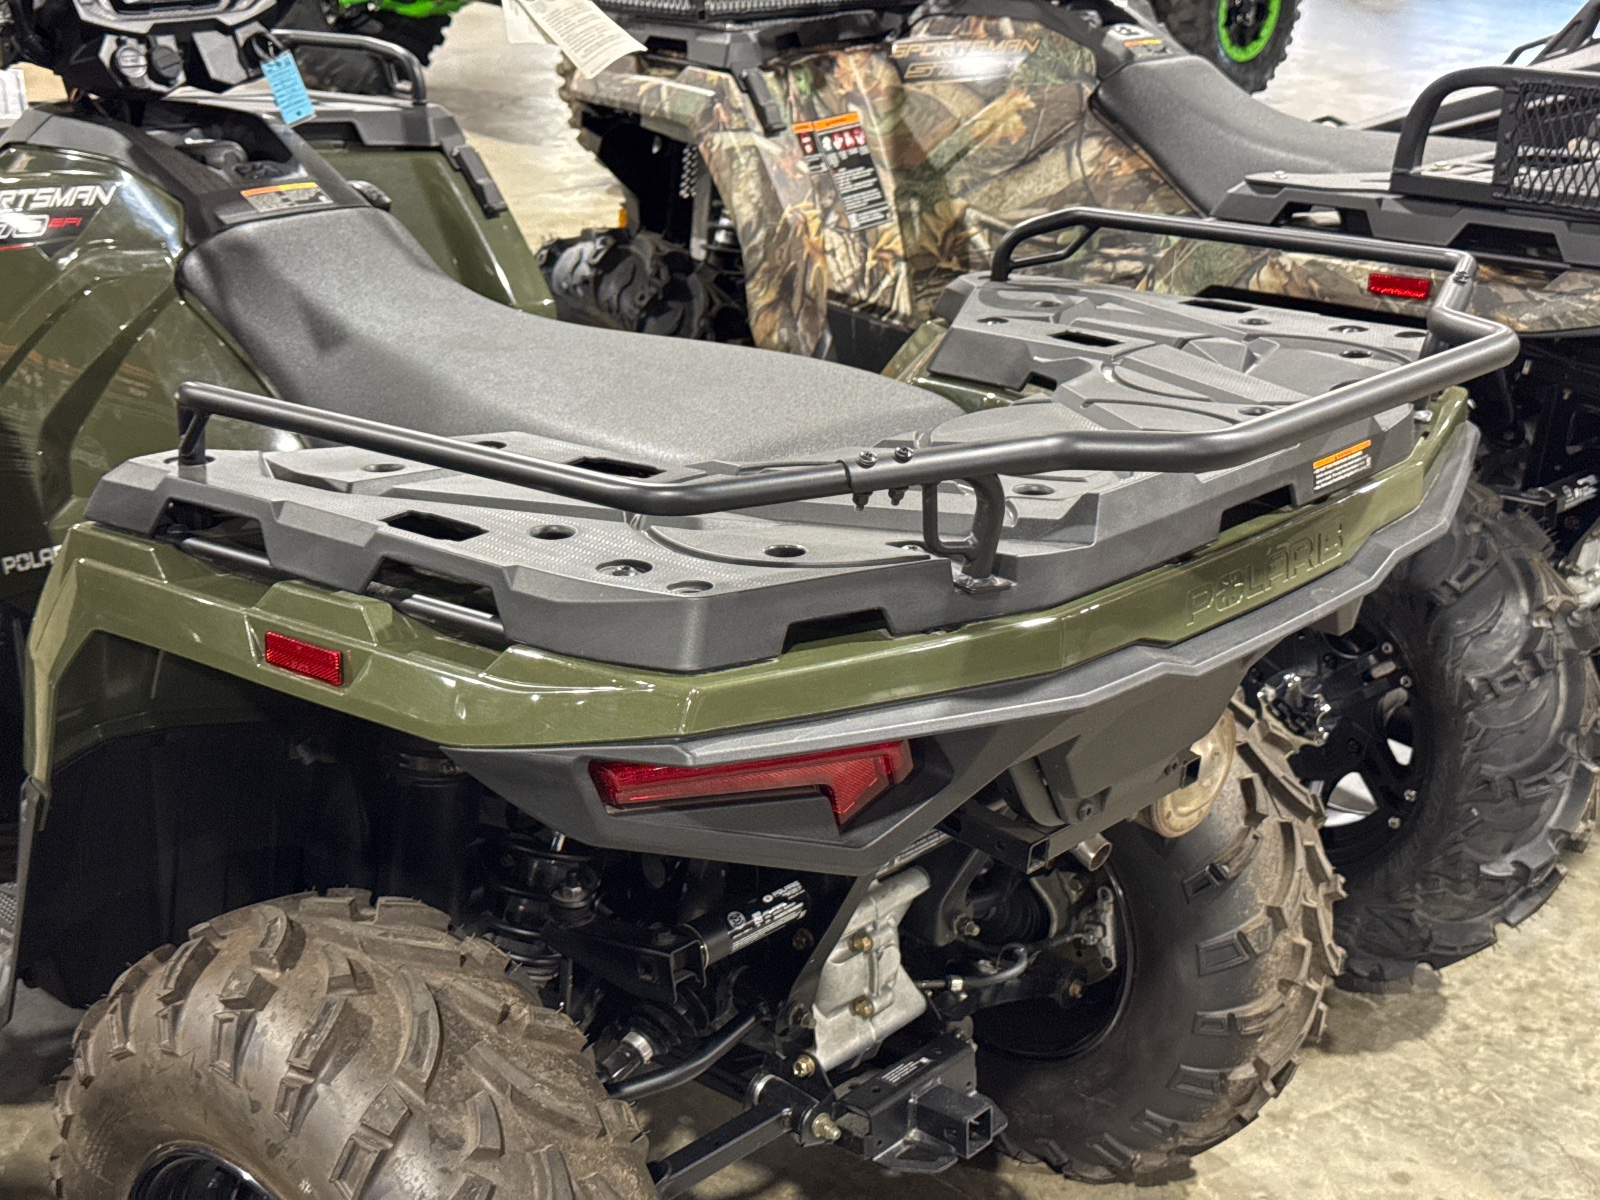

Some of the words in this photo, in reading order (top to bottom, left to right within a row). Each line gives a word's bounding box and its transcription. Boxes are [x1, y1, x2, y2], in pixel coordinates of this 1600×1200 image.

[889, 38, 1041, 59] SPORTSMAN
[47, 216, 83, 229] EFI
[1184, 522, 1345, 627] POLARIS
